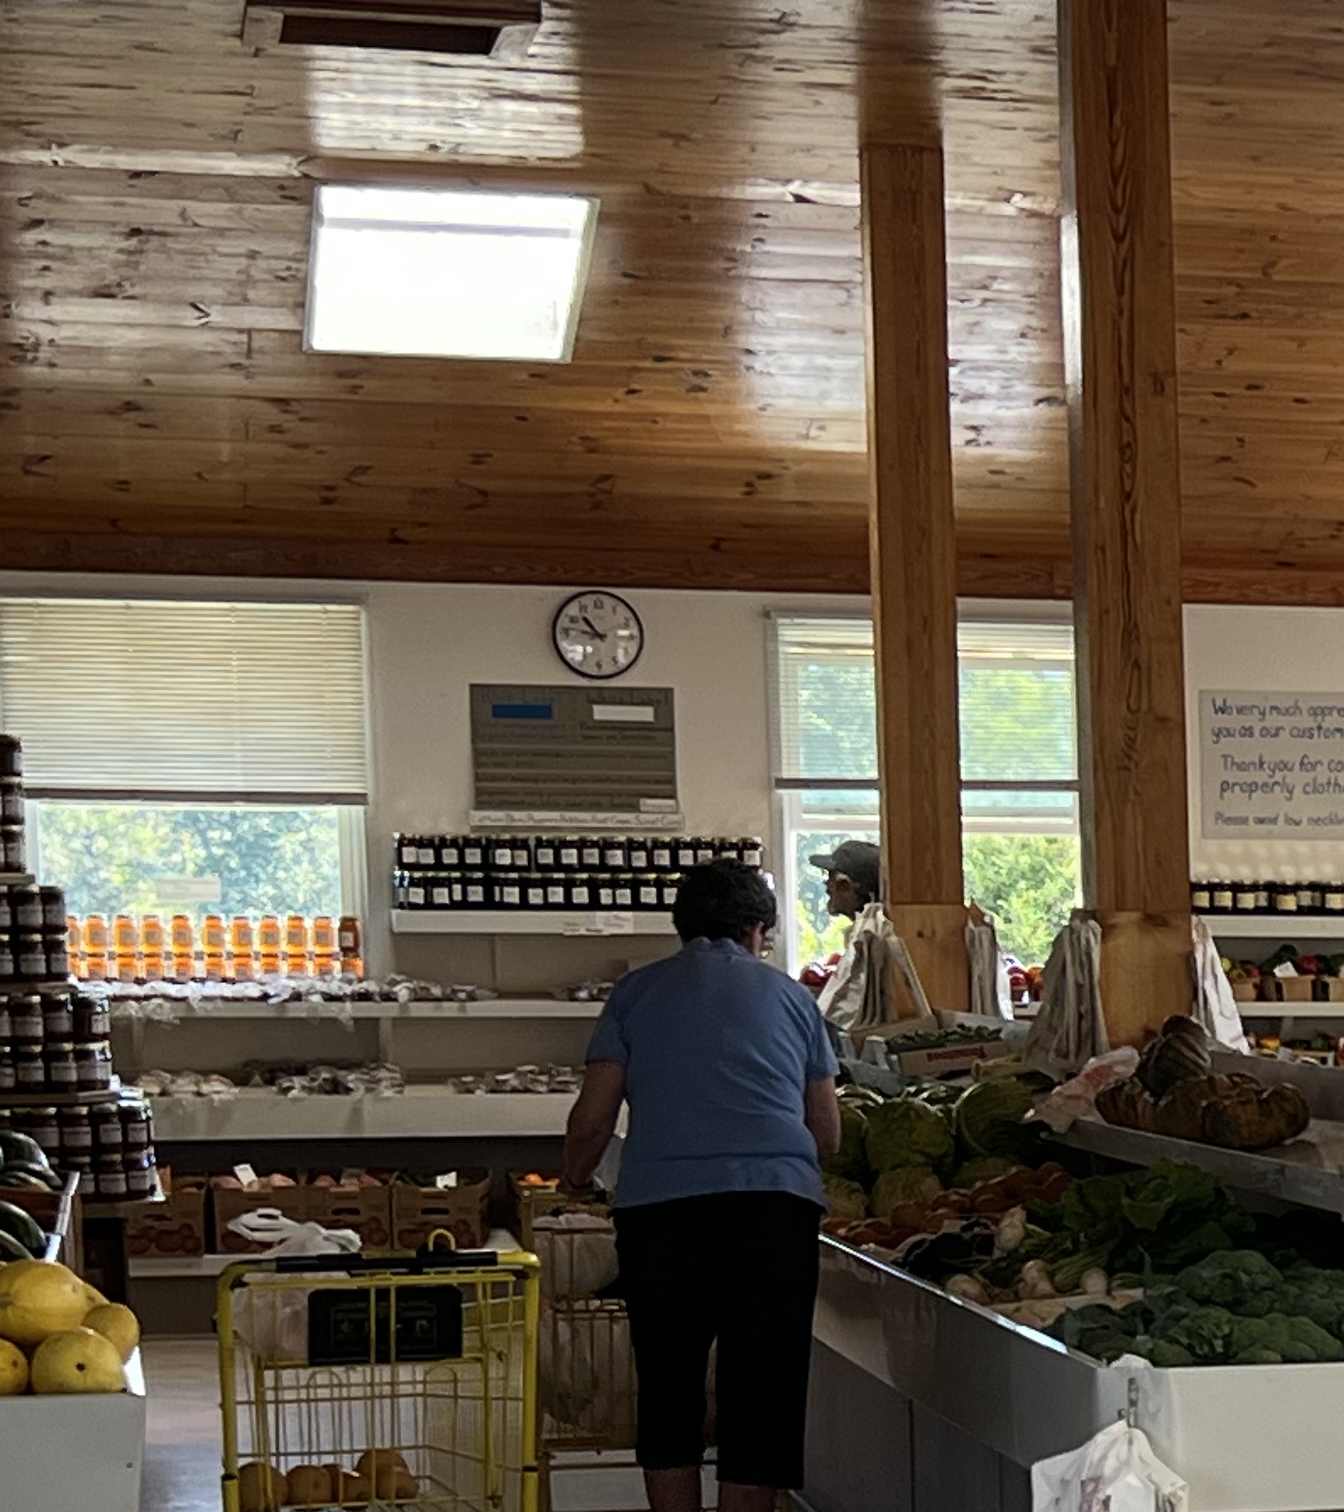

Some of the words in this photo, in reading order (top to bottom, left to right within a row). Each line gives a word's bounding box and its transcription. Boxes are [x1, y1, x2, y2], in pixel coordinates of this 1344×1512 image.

[1236, 704, 1266, 723] very
[1269, 699, 1302, 717] much
[1211, 726, 1236, 744] you
[1238, 725, 1254, 738] as
[1259, 725, 1285, 738] our
[1221, 753, 1266, 772] Thank
[1266, 760, 1295, 779] you
[1299, 754, 1323, 773] for
[1219, 775, 1295, 801] properly
